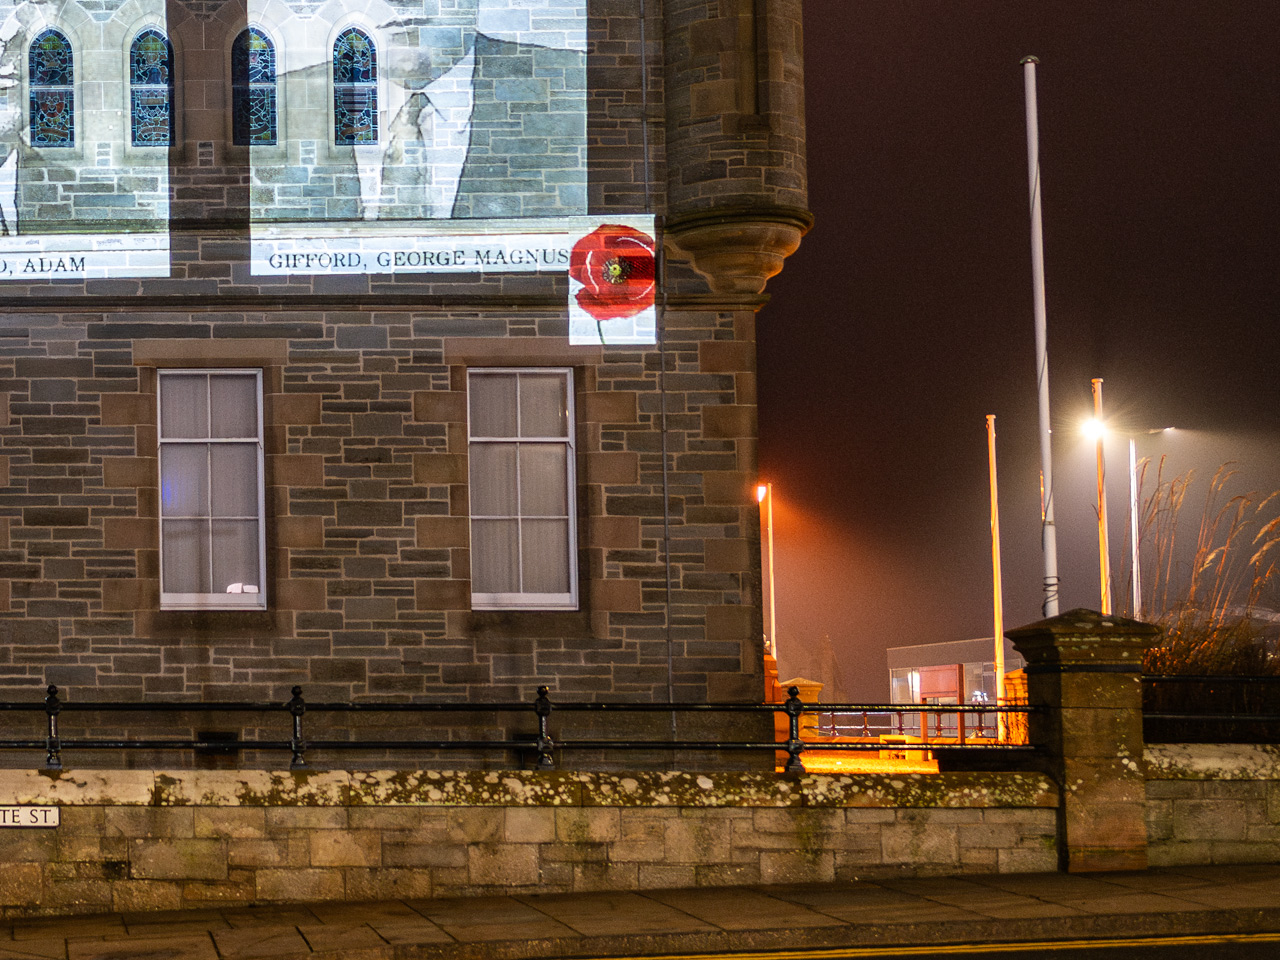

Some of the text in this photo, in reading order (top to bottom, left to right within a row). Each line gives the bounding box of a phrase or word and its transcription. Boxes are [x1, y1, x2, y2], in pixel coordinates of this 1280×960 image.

[22, 257, 86, 273] ADAM
[269, 248, 570, 271] GIFFORD, GEORGE MAGNUS
[29, 808, 56, 824] ST.
